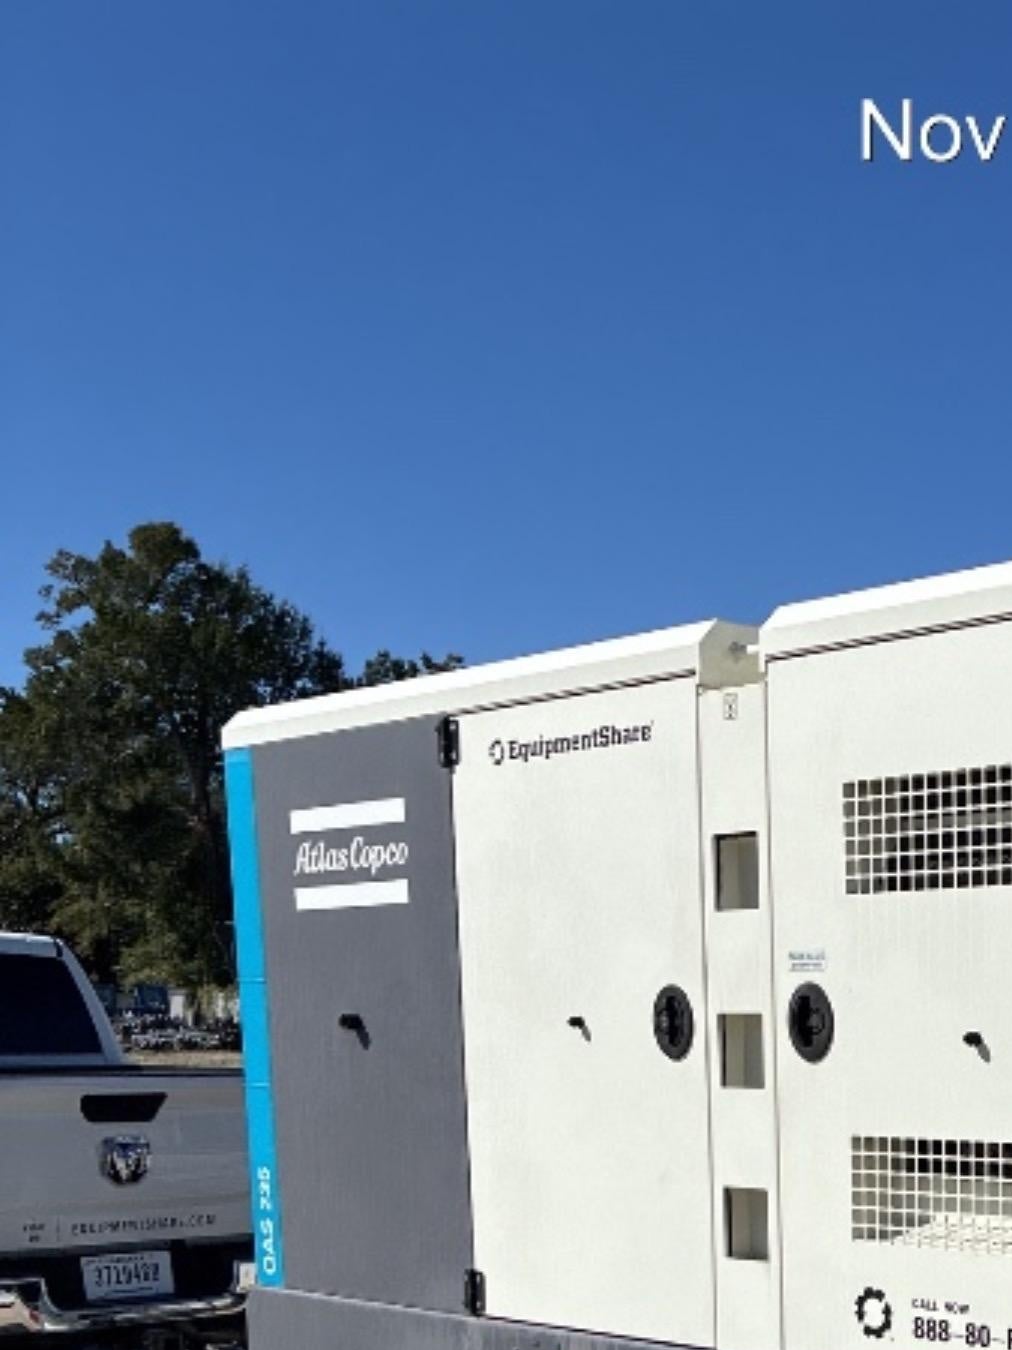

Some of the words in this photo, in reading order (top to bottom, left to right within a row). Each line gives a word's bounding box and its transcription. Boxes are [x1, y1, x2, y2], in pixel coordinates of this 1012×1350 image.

[507, 724, 652, 763] EquipmentShare
[293, 840, 348, 877] Atlas
[349, 836, 409, 876] Copco
